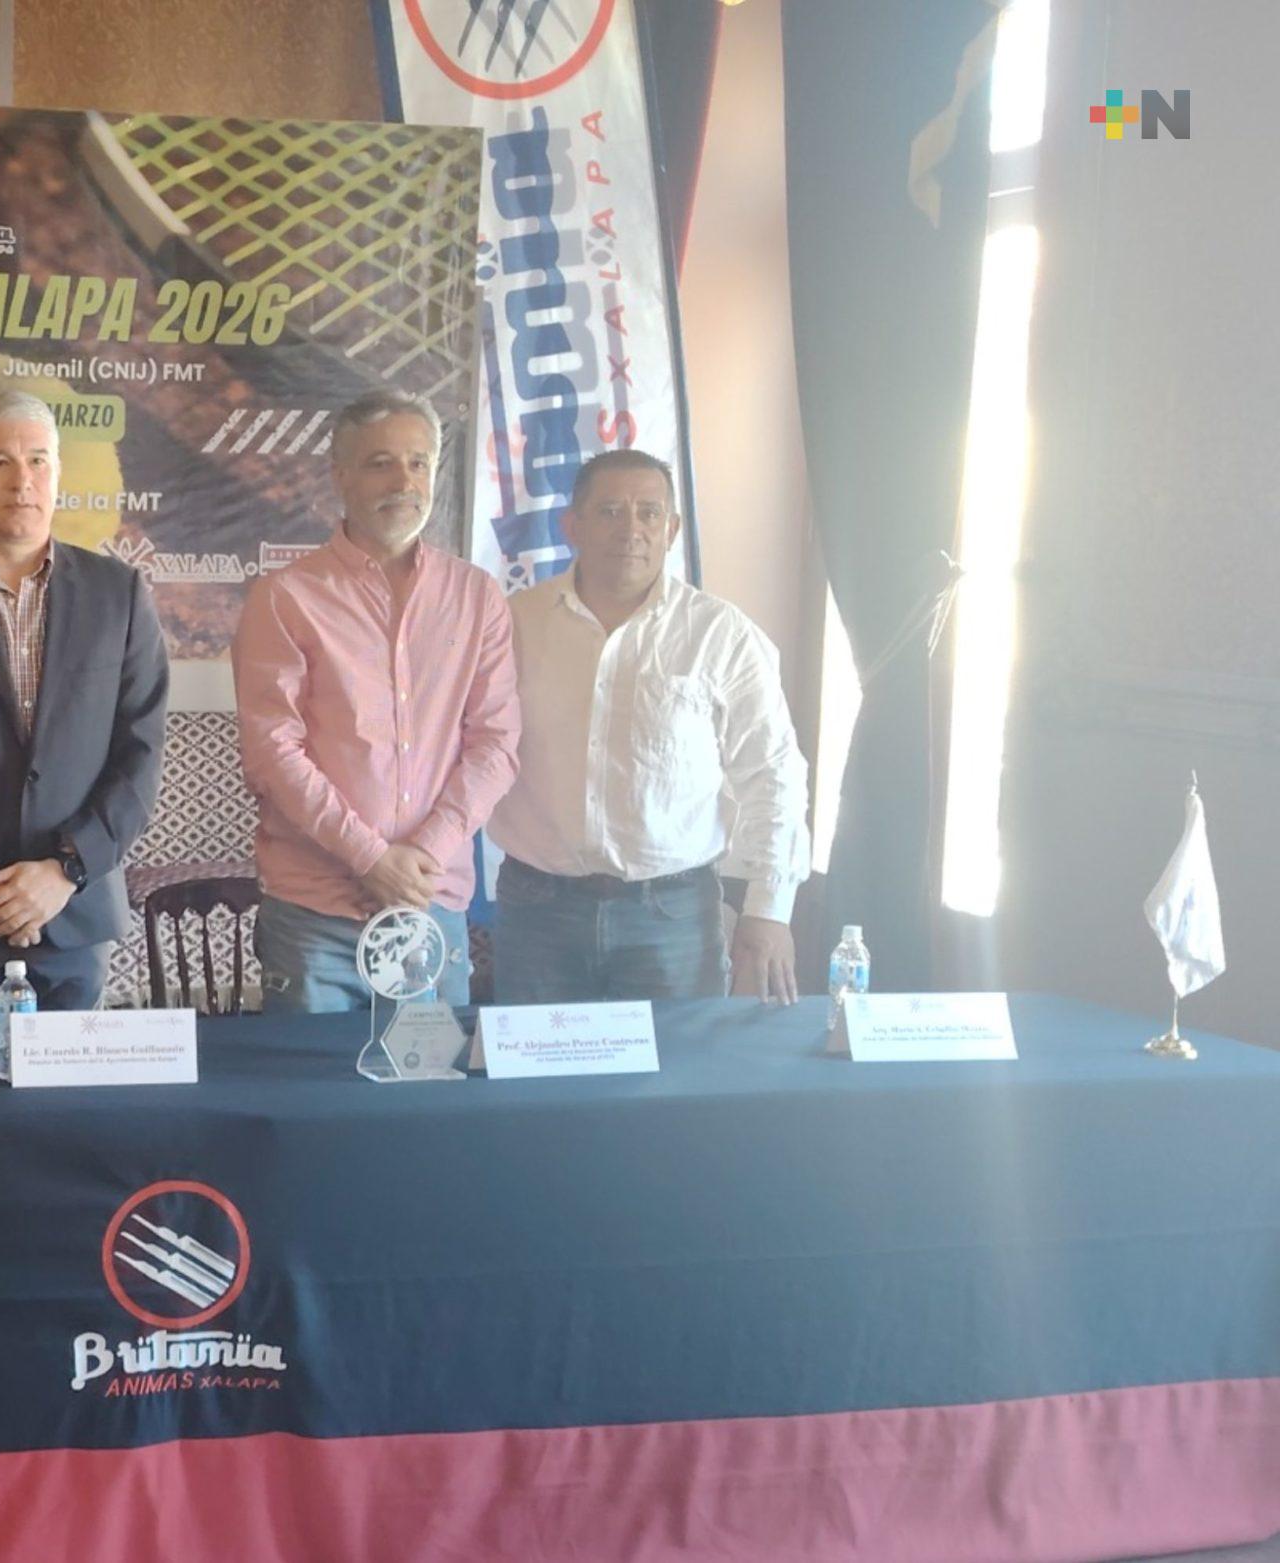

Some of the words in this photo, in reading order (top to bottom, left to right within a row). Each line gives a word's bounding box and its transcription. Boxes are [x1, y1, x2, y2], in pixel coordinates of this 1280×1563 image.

[580, 109, 634, 387] XALAPA
[147, 278, 293, 346] 2026
[2, 357, 83, 380] Juvenil
[88, 358, 158, 384] (CNIJ)
[162, 362, 206, 382] FMT
[88, 491, 109, 511] la
[115, 491, 163, 512] FMT
[153, 554, 243, 576] XALAPA
[524, 1039, 570, 1051] Alejandro
[601, 1037, 650, 1047] Contreras
[104, 1371, 195, 1398] ANIMAS
[199, 1374, 281, 1390] XALAPA
